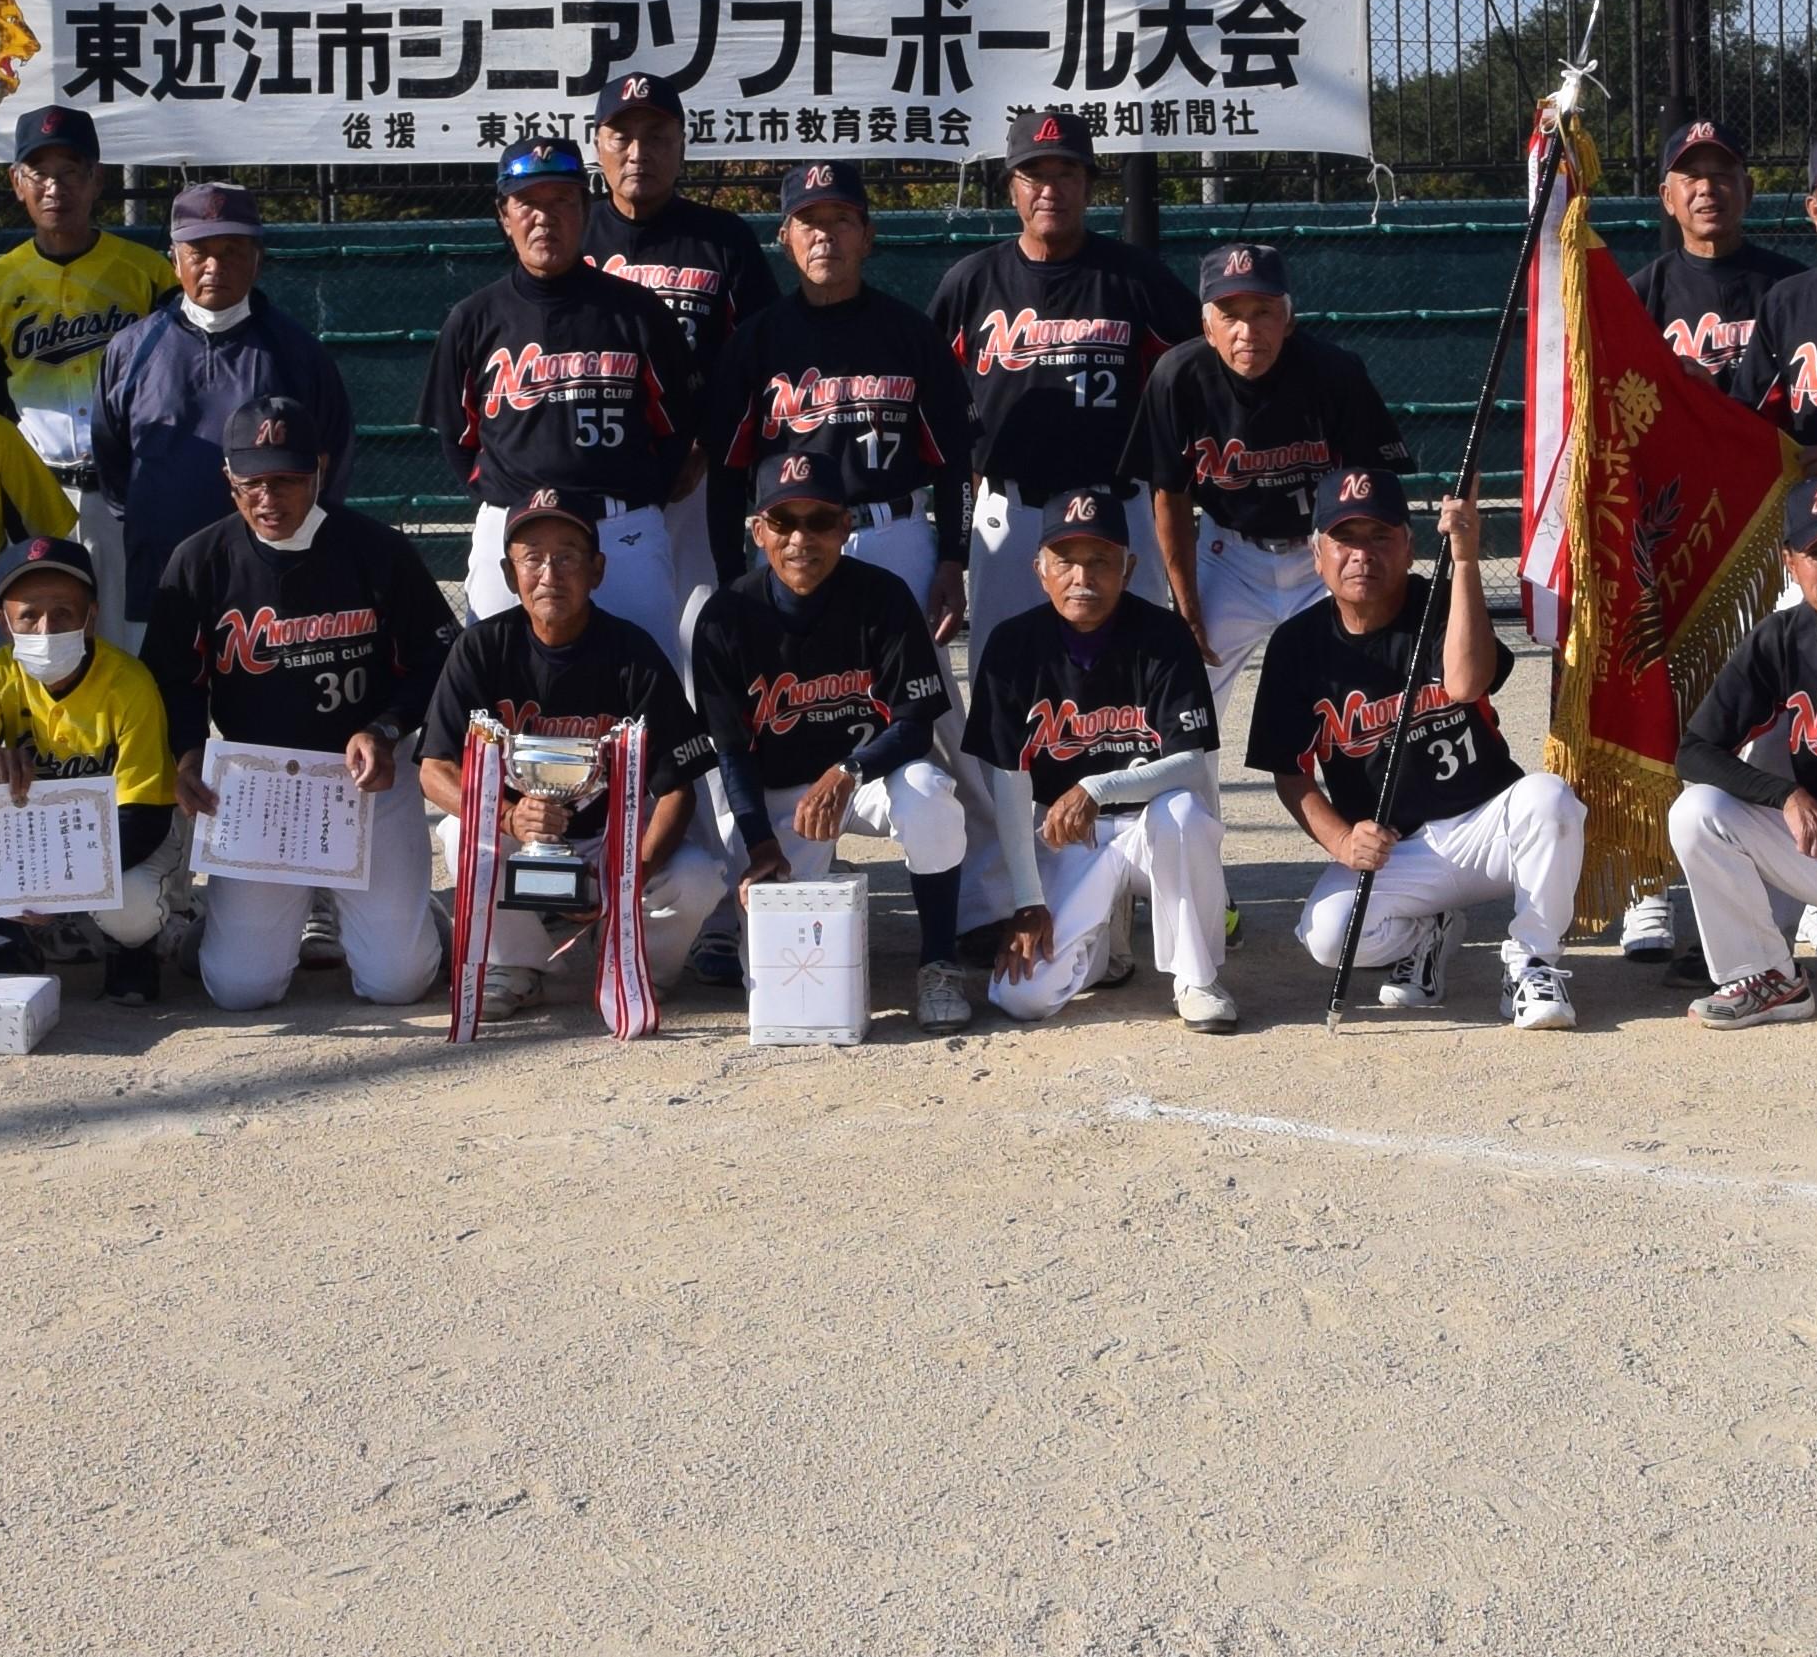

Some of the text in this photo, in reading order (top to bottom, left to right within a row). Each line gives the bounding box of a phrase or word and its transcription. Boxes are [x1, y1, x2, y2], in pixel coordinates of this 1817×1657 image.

[1023, 317, 1131, 347] NOTOGAWA
[531, 351, 639, 383] NOTOGAWA
[1038, 352, 1126, 367] SENIOR CLUB
[547, 387, 634, 404] SENIOR CLUB
[812, 374, 916, 406] NOTOGAWA
[1065, 369, 1118, 409] 12
[575, 408, 626, 448] 55
[827, 410, 909, 425] SENIOR CLUB
[856, 431, 902, 471] 17
[1238, 438, 1331, 471] NOTOGAW
[1256, 473, 1307, 490] SENIOR
[265, 608, 378, 648] NOTOGAWA
[284, 644, 374, 670] SENIOR CLUB
[313, 666, 368, 715] 30
[806, 705, 856, 723] SENIOR
[1432, 709, 1468, 733] CLUB
[1088, 739, 1136, 758] SENIOR
[1427, 725, 1479, 782] 31
